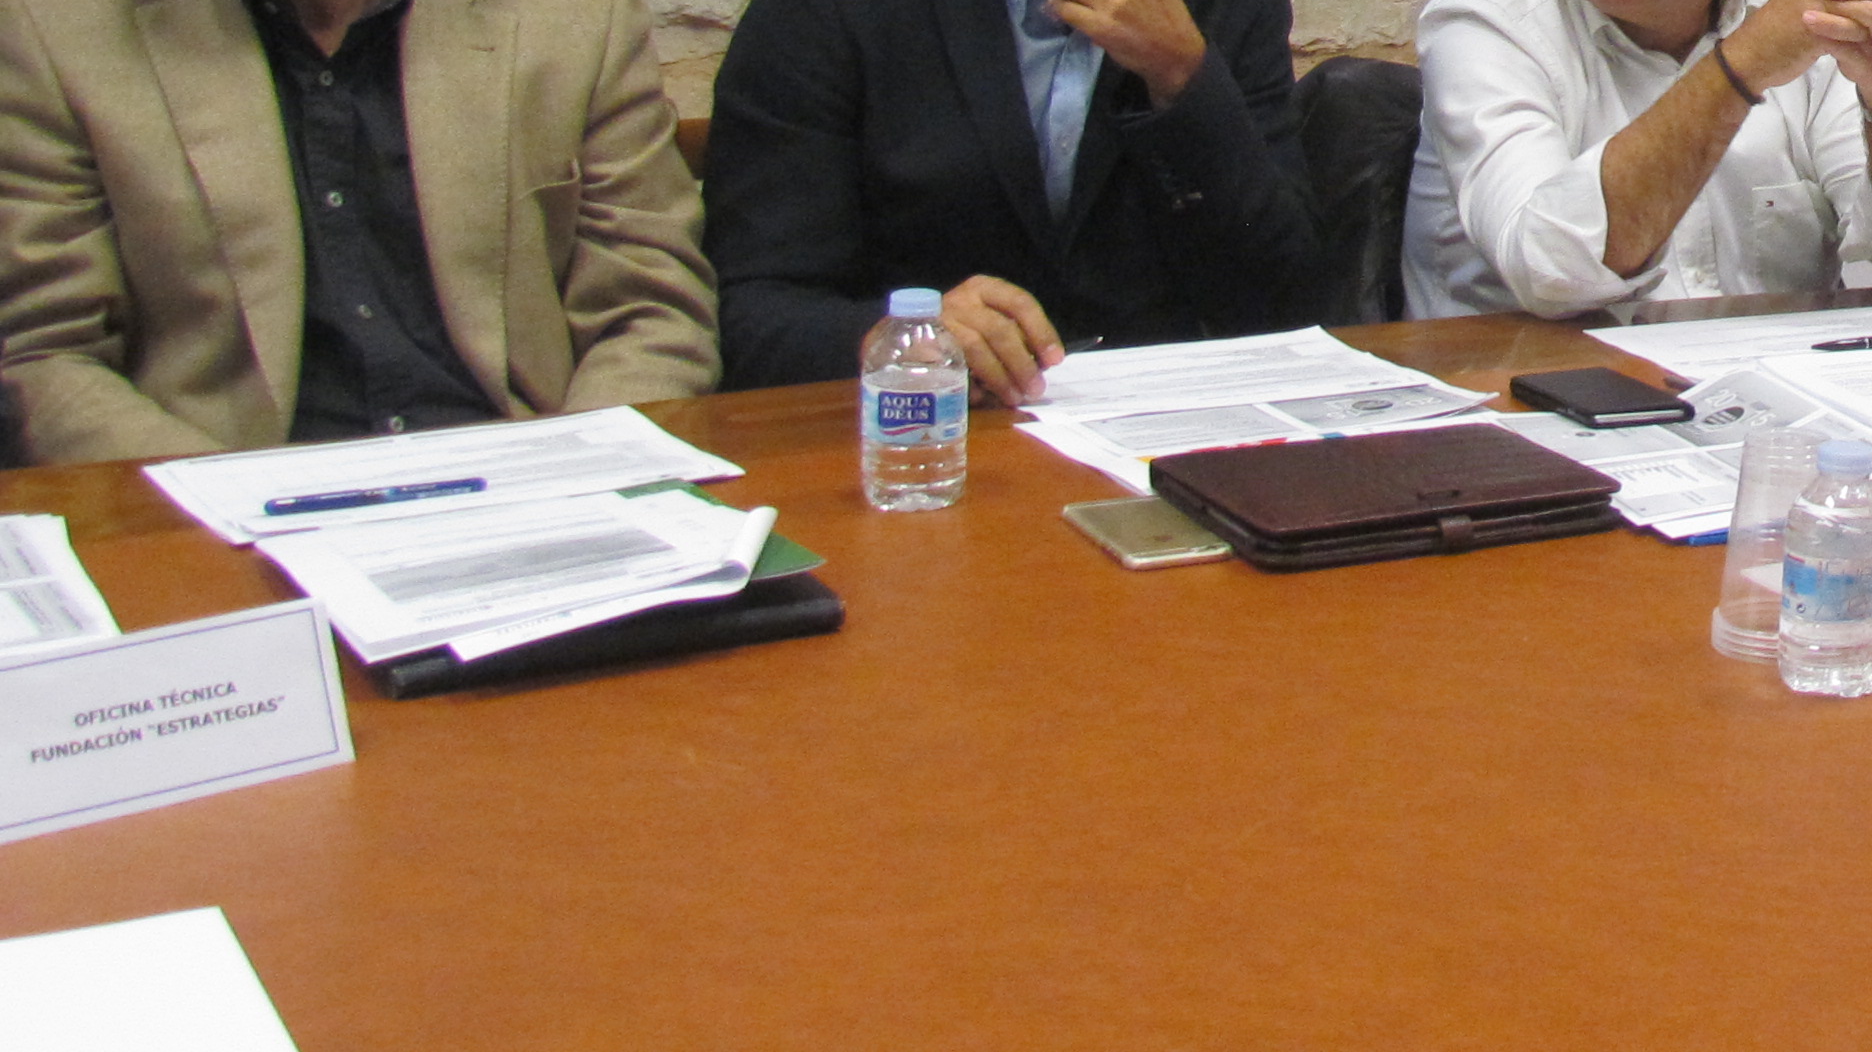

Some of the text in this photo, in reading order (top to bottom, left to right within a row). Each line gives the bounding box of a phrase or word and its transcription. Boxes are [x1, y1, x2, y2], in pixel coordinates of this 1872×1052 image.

[881, 396, 931, 408] AQUA
[884, 408, 929, 420] DEUS
[74, 681, 237, 727] OFICINA TÉCNICA
[30, 727, 143, 763] FUNDACIÓN
